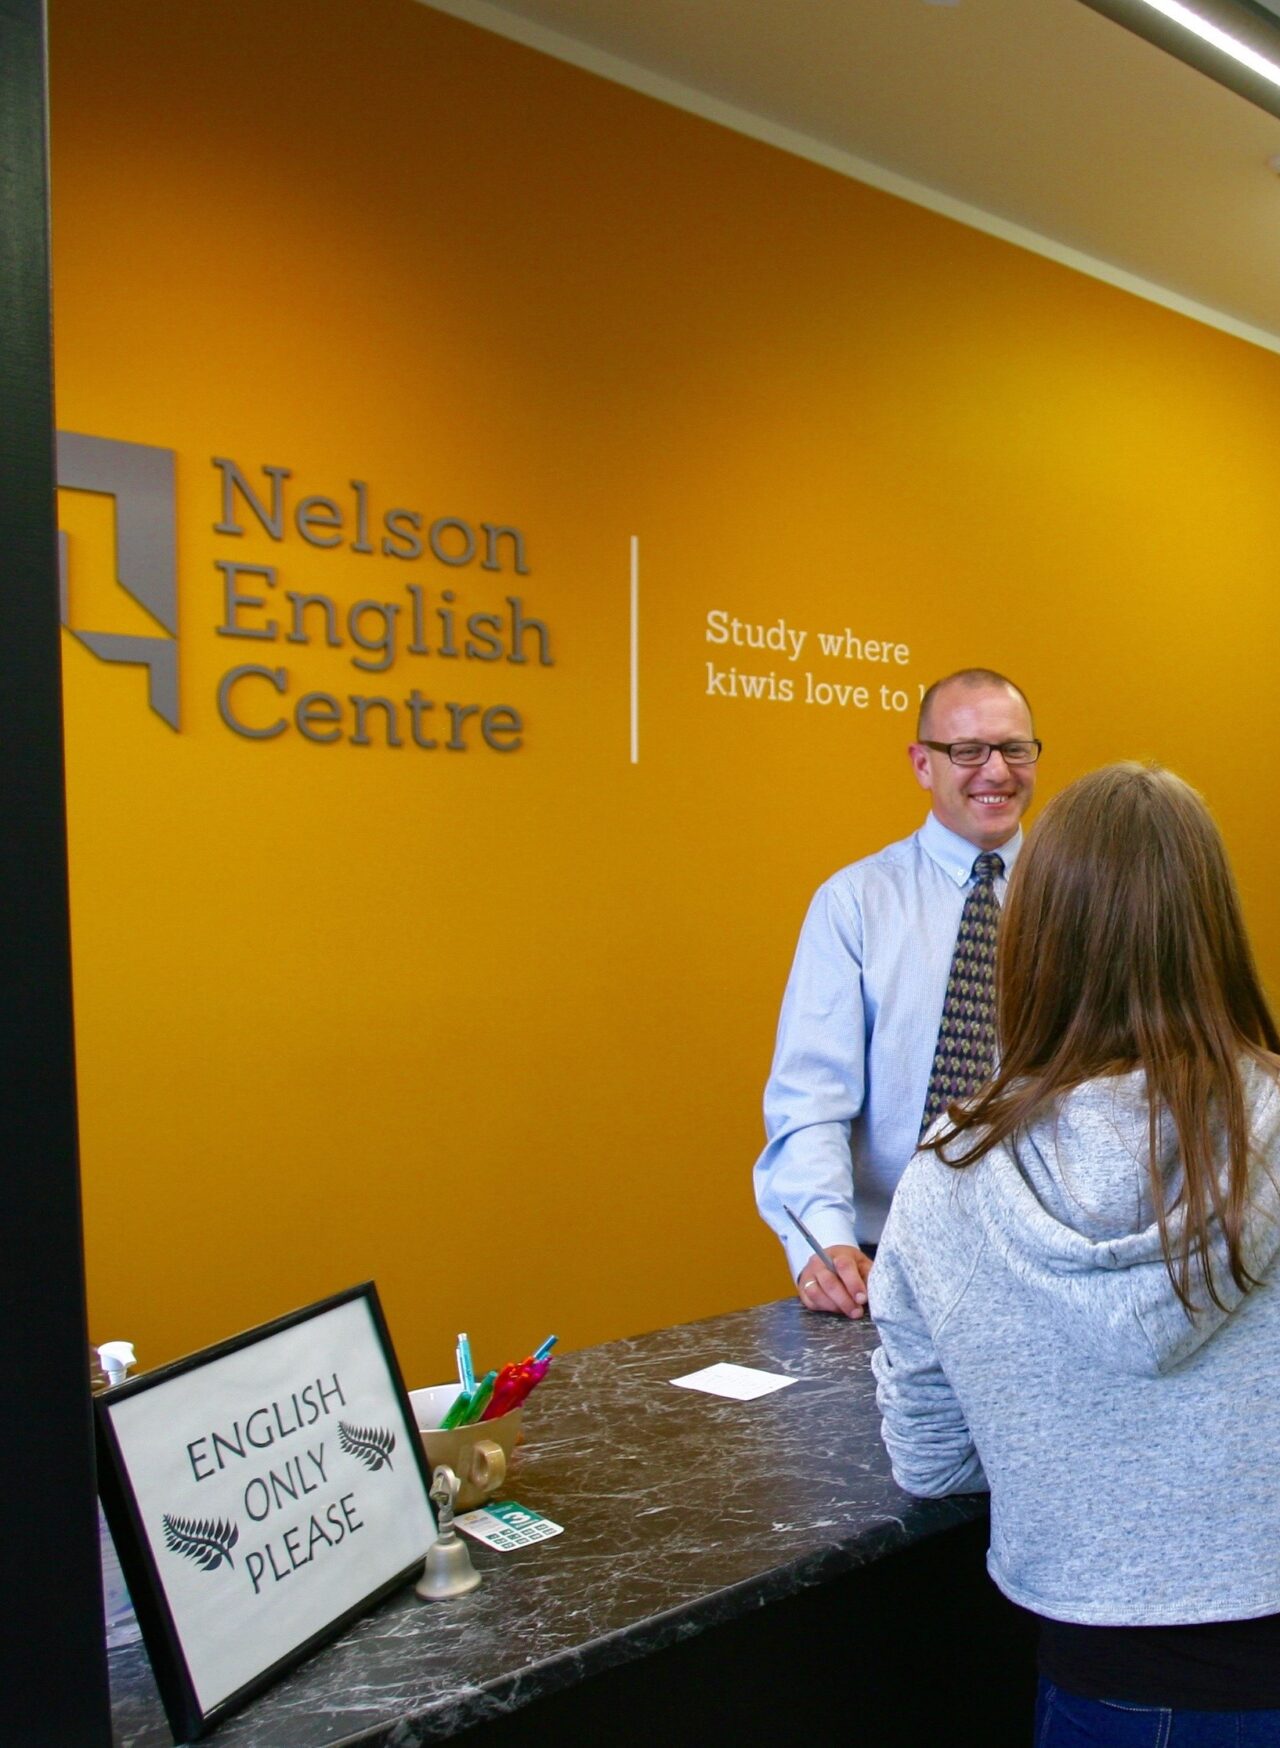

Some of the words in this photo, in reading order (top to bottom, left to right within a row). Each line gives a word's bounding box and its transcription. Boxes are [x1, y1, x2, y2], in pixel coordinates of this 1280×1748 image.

[212, 456, 531, 575] Nelson
[215, 559, 555, 673] English
[705, 610, 807, 661] Study
[817, 627, 910, 665] where
[217, 664, 525, 753] Centre
[705, 662, 795, 702] kiwis
[805, 672, 869, 708] love
[880, 684, 909, 711] to
[186, 1373, 346, 1482] ENGLISH
[243, 1442, 330, 1522] ONLY
[245, 1493, 364, 1594] PLEASE
